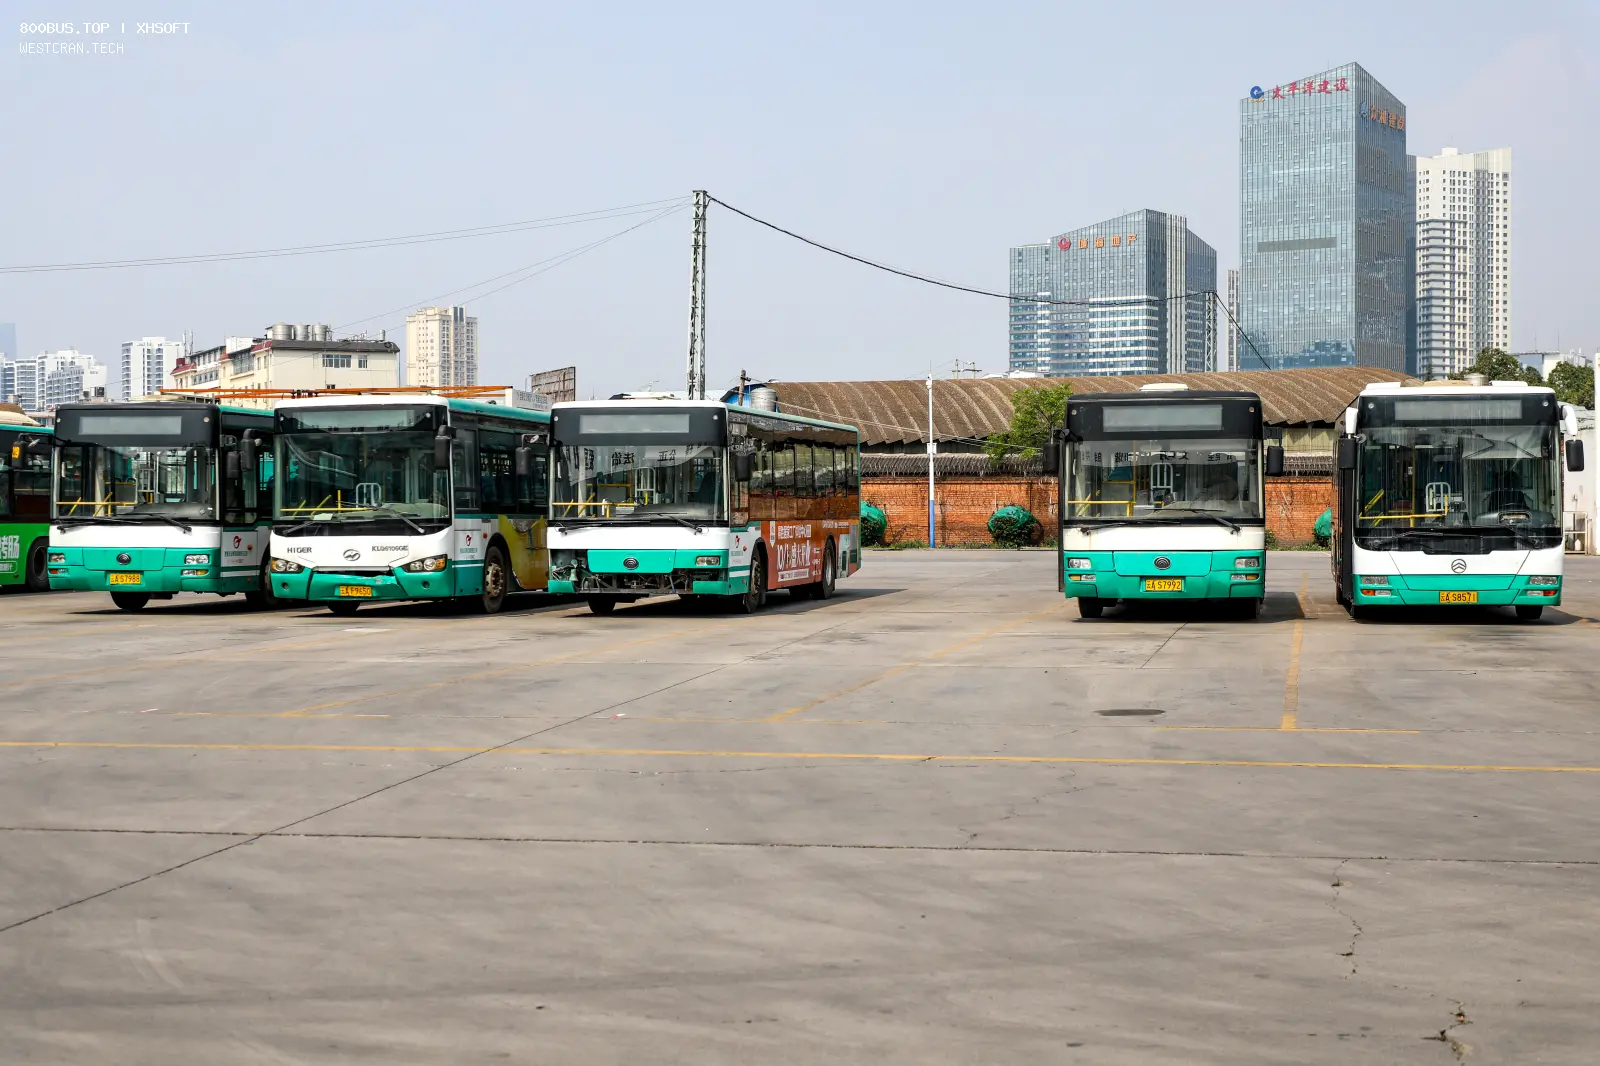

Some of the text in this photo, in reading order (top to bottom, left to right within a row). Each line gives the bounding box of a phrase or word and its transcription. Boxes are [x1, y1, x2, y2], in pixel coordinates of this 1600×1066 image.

[1272, 78, 1350, 100] 太平洋建设
